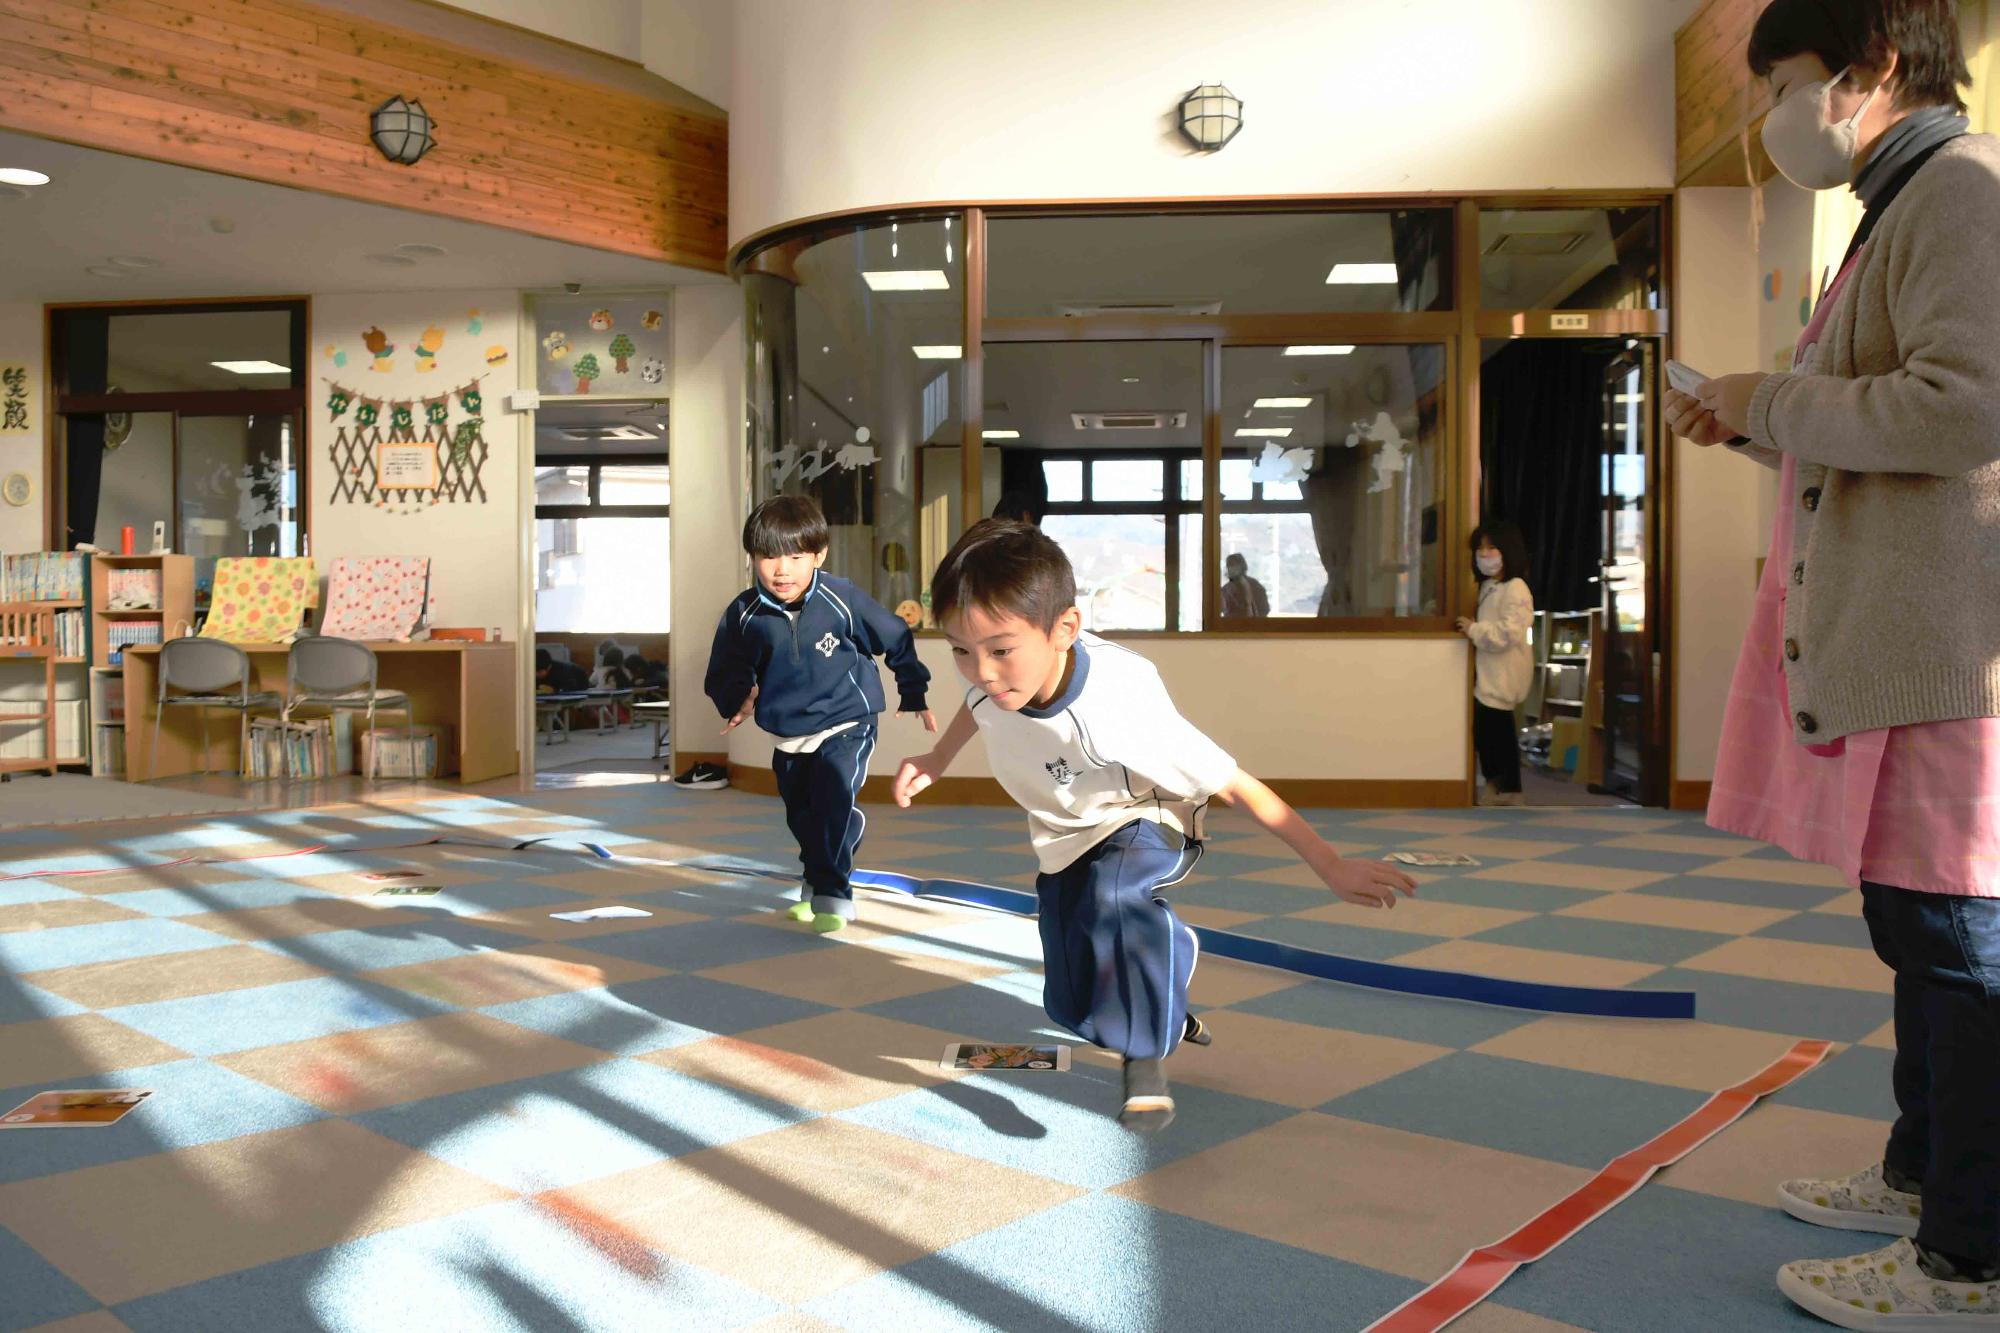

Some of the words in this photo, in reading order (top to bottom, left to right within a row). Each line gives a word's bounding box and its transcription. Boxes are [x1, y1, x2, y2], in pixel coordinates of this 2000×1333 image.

[2, 366, 30, 430] 笑顔
[331, 397, 479, 425] けいじばん
